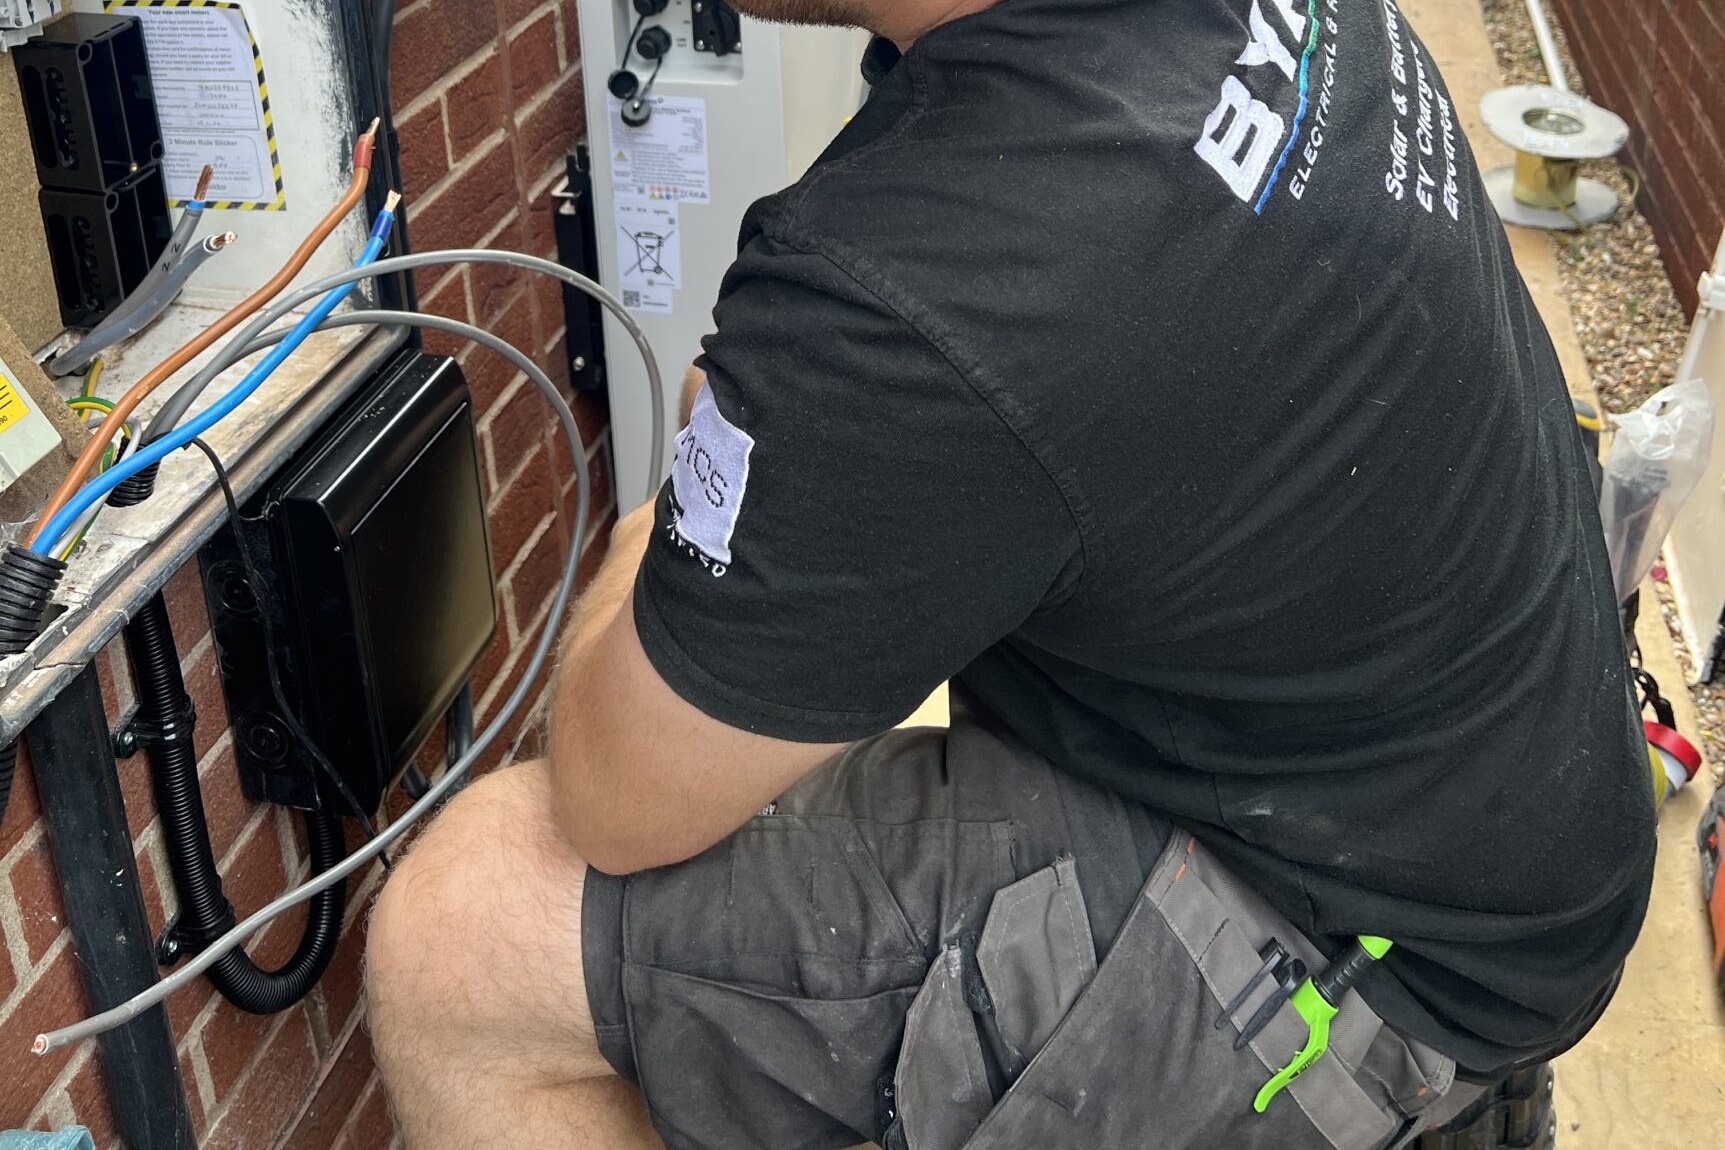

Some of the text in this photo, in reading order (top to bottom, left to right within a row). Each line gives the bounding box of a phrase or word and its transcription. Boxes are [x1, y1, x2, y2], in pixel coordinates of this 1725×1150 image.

[1289, 42, 1337, 201] ELECTRICAL
[1391, 88, 1408, 116] &
[1385, 119, 1408, 201] Solar
[1415, 155, 1436, 213] EV
[681, 424, 729, 508] MCS
